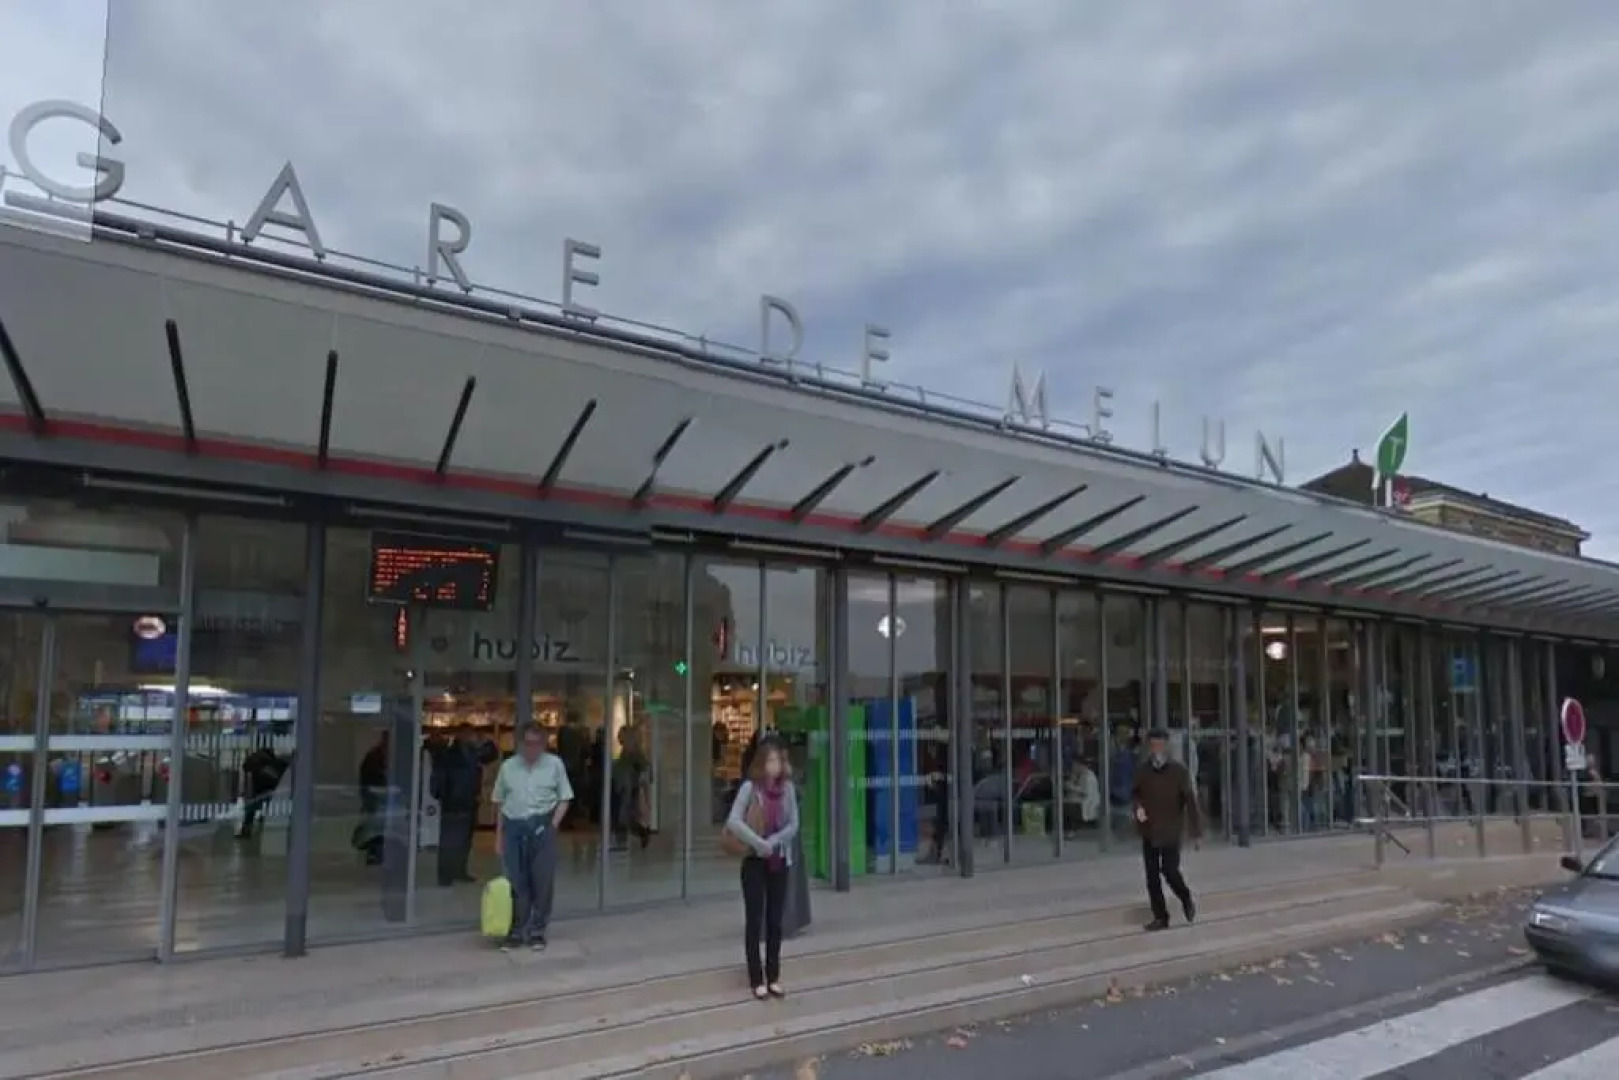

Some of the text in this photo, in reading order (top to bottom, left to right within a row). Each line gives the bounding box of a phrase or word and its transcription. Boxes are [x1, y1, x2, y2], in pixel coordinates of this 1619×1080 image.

[8, 99, 1285, 484] GARE DE MELUN
